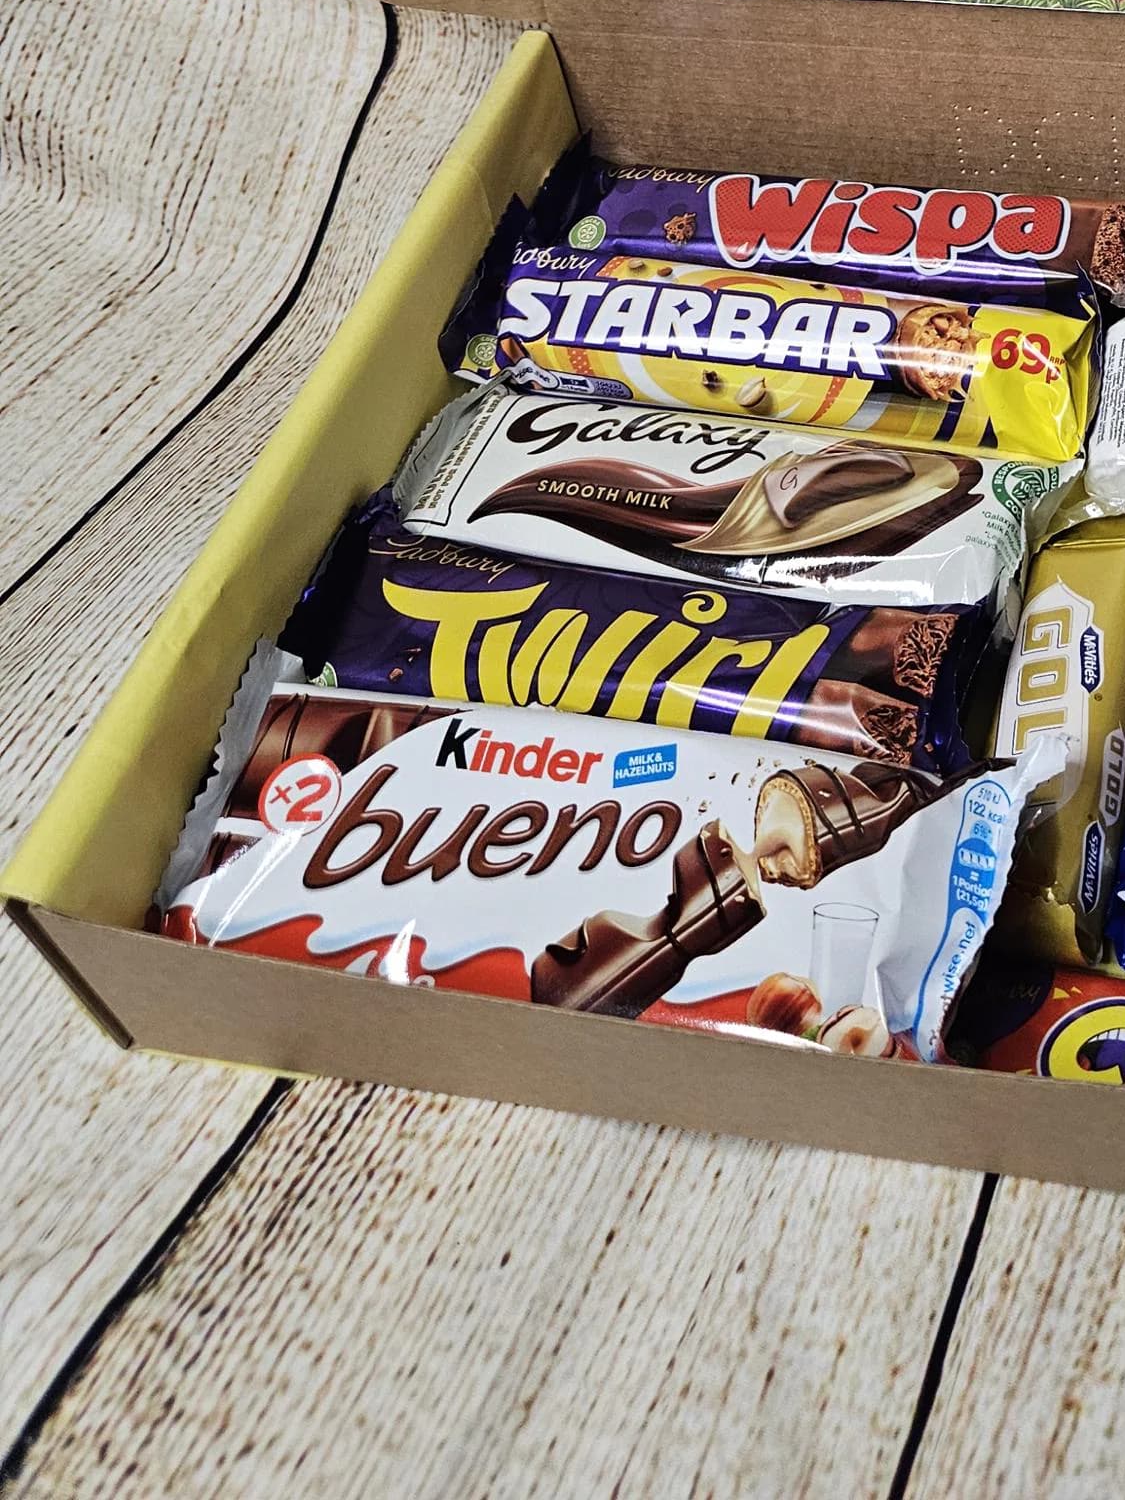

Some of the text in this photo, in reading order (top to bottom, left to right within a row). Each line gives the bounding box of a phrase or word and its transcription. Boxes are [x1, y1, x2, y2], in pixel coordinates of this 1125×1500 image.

[711, 176, 1069, 275] Wispa
[499, 279, 893, 379] STARBAR
[506, 402, 770, 474] Galaxy
[537, 479, 672, 511] SMOOTH MILK
[382, 577, 830, 740] Twirl
[1011, 606, 1073, 755] GOL
[435, 718, 603, 784] Kinder
[615, 760, 675, 779] HAZELNUTS
[629, 753, 655, 766] MILK
[1104, 736, 1125, 822] GOLD
[302, 764, 683, 889] bueno
[969, 800, 985, 818] 122
